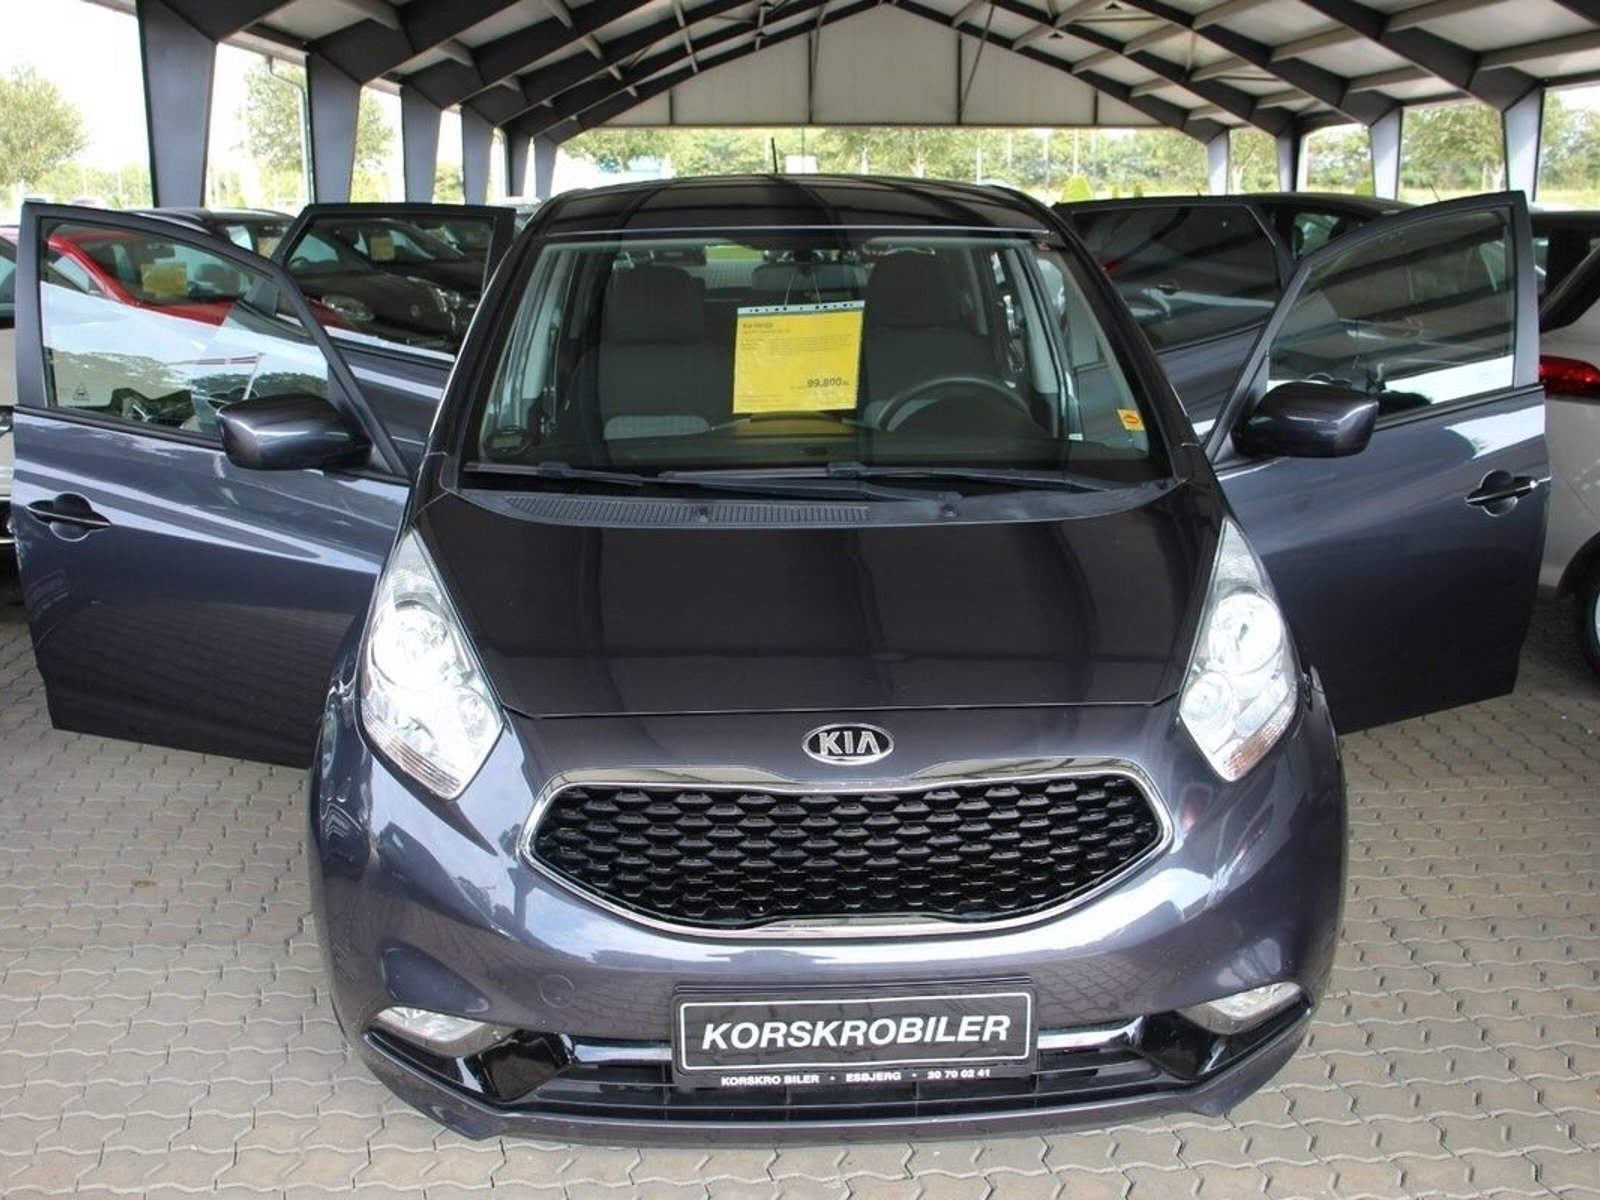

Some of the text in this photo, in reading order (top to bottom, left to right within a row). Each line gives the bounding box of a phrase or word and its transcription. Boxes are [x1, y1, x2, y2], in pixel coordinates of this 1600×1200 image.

[818, 730, 881, 756] KIA
[701, 1014, 1010, 1050] KORSKROBILER
[721, 1068, 991, 1087] KORSKRO BILER ESBJERG 20 70 02 41
